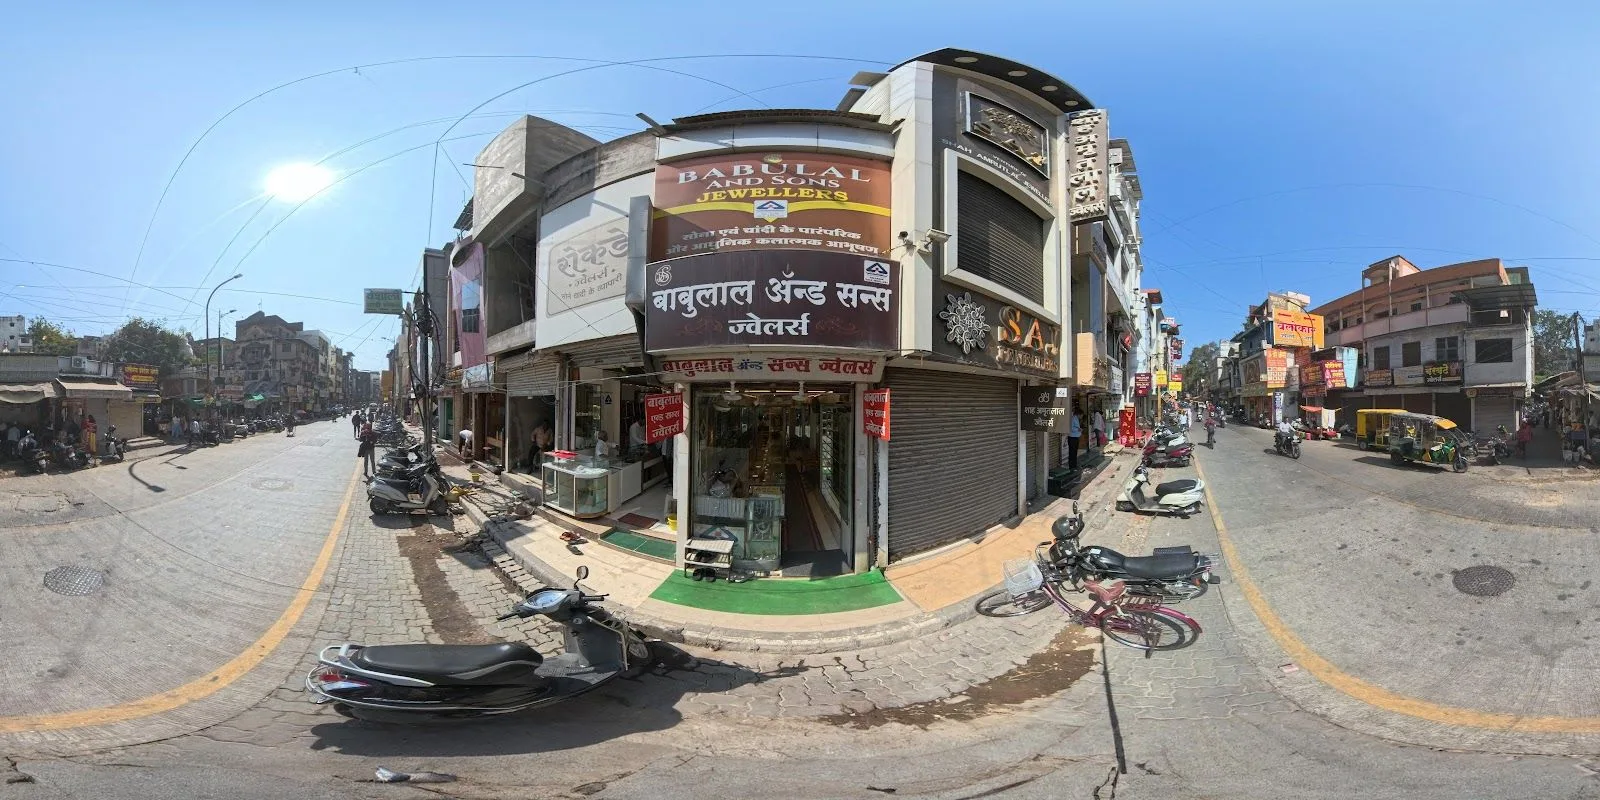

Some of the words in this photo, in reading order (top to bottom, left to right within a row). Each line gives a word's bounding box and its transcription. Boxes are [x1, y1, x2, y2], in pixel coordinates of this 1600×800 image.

[678, 163, 872, 184] BABULAL
[706, 177, 763, 190] AND
[771, 175, 840, 188] SONS
[696, 187, 849, 202] JEWELLERS
[719, 226, 739, 236] एवं
[743, 224, 776, 234] चांदी
[779, 224, 795, 233] के
[798, 226, 861, 239] पारंपरिक
[665, 243, 688, 254] और
[691, 237, 752, 250] आधुनिक
[755, 237, 822, 246] कलात्मक
[826, 240, 879, 254] आभूषण
[652, 279, 755, 318] बाबुलाल
[836, 281, 893, 312] सन्स
[728, 312, 812, 336] ज्वेलर्स
[661, 357, 735, 377] बाबुलाल
[767, 357, 811, 373] सन्स
[818, 357, 877, 375] ज्वेलर्स
[647, 396, 682, 410] बाबुलाल
[652, 420, 680, 438] ज्वेलर्स
